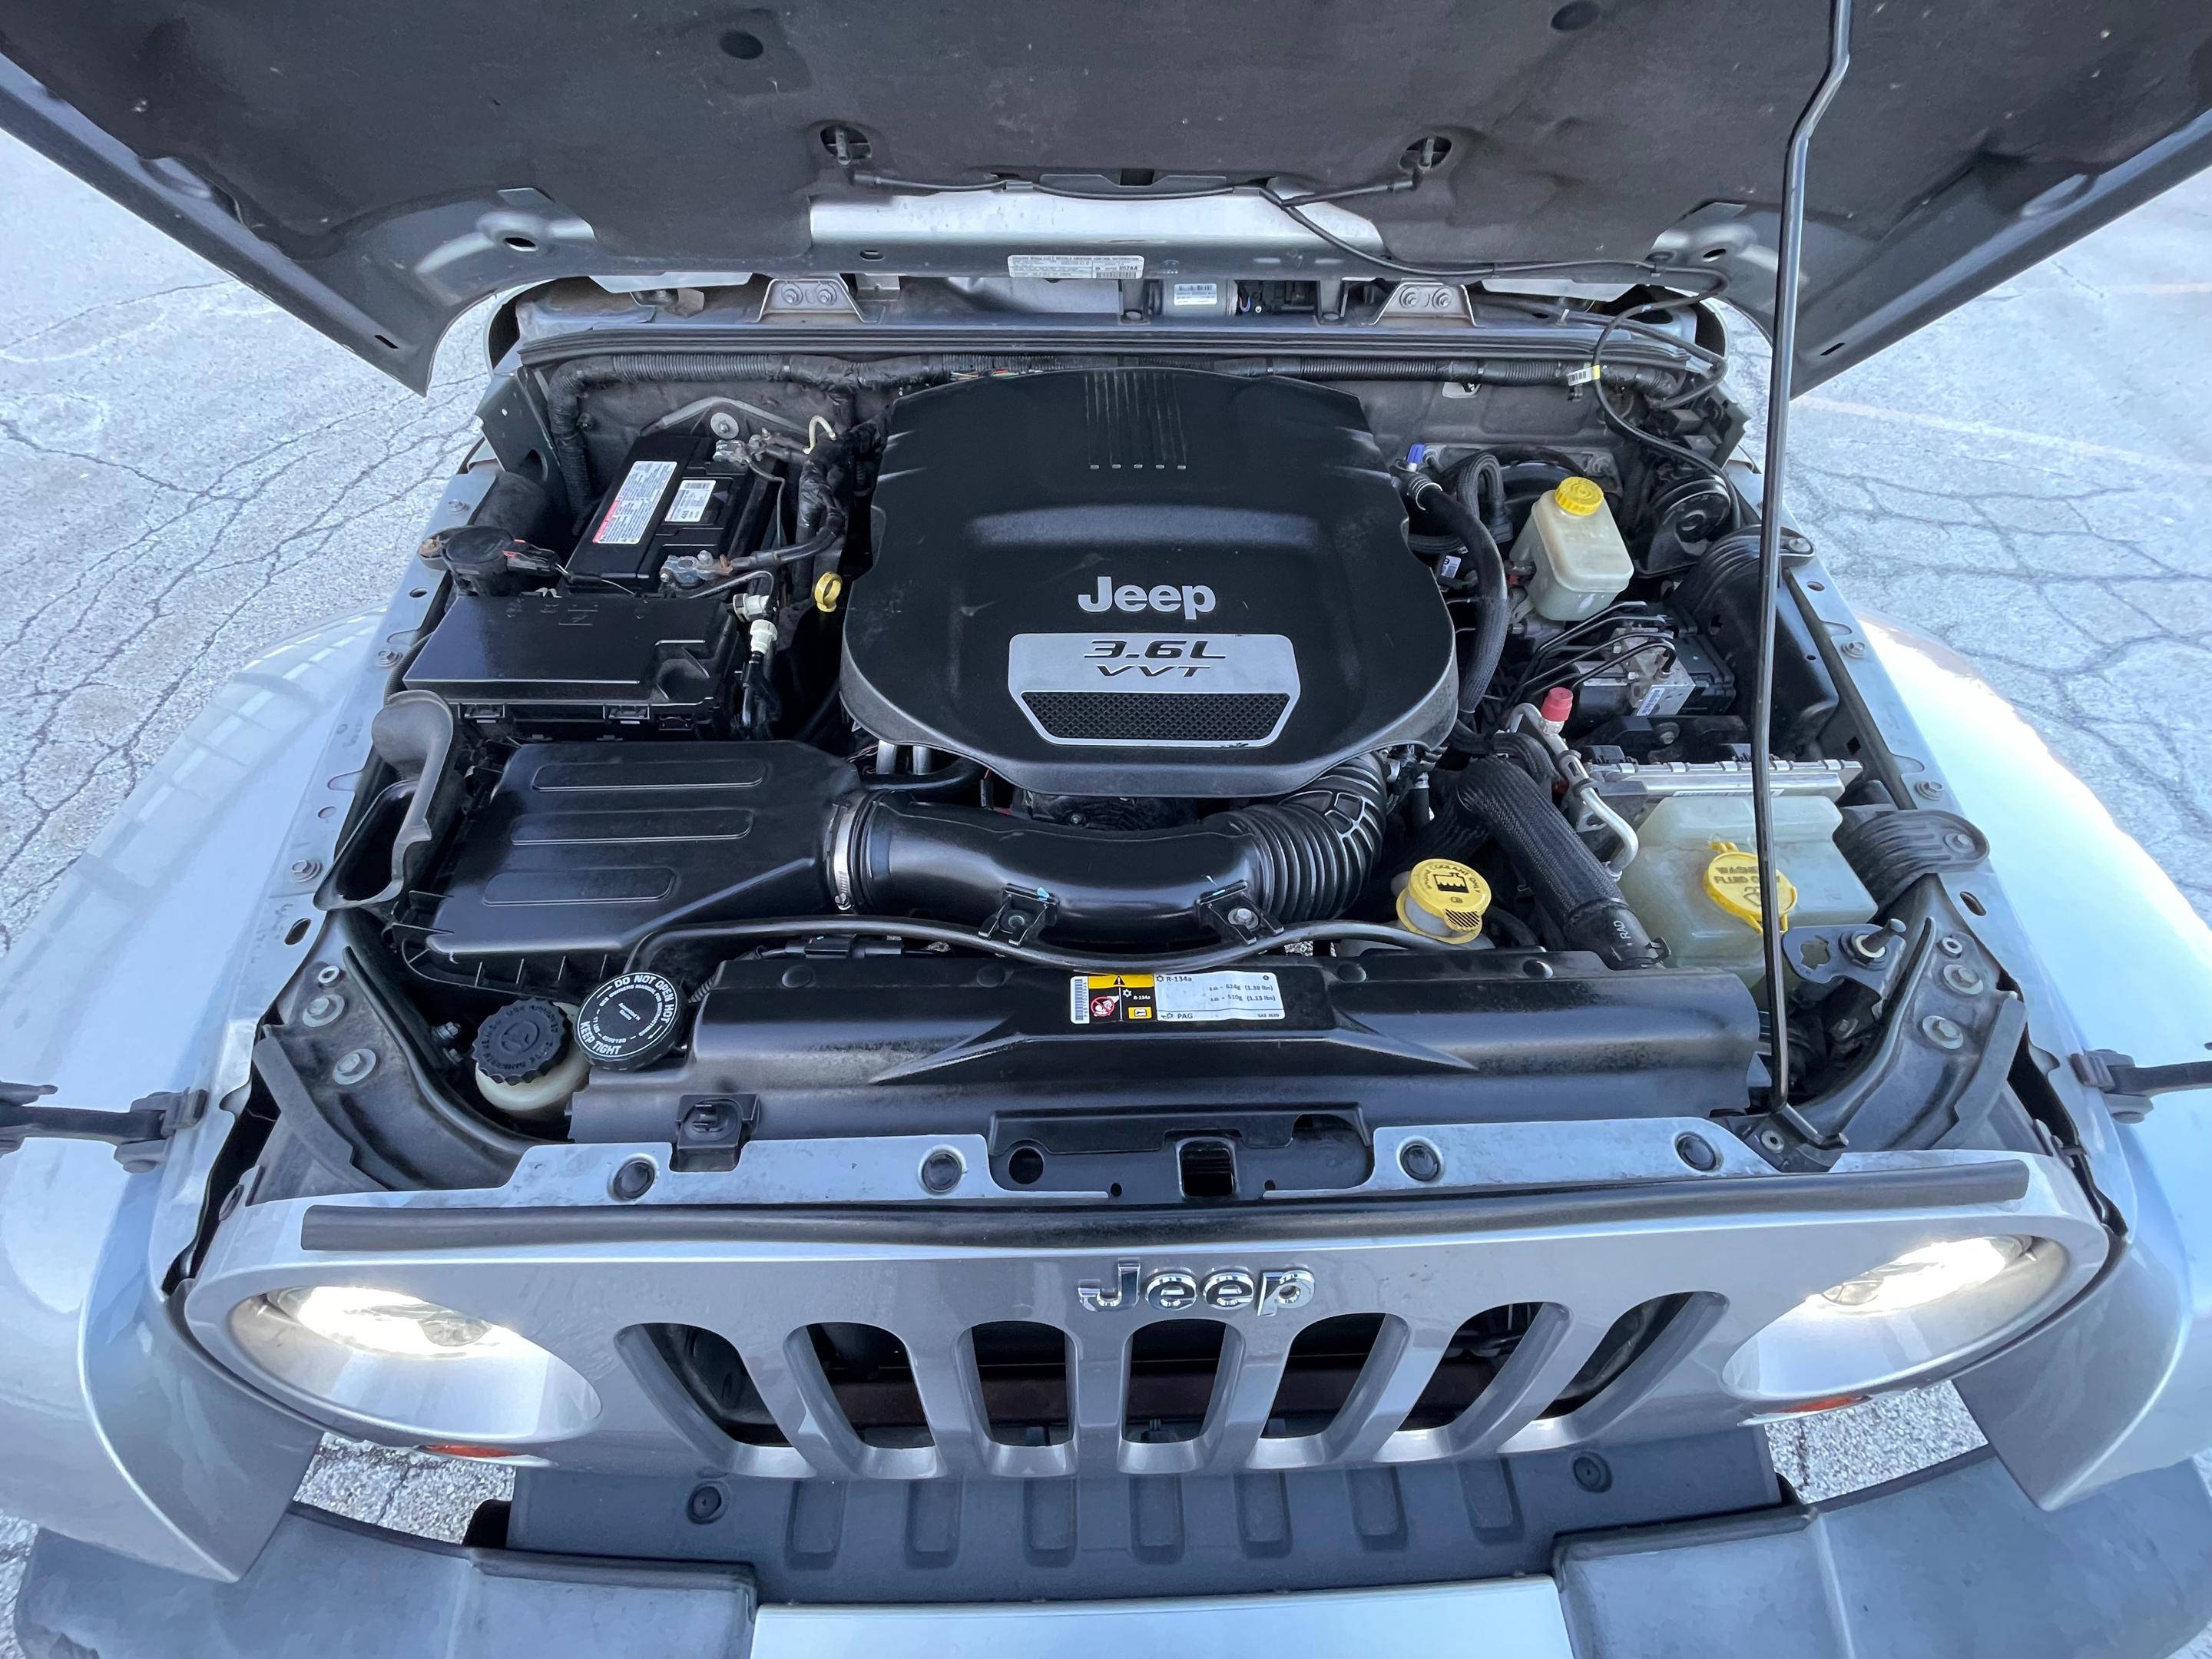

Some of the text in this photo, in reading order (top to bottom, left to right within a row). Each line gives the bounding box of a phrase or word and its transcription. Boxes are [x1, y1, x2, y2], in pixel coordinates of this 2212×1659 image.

[1078, 576, 1216, 621] Jeep
[1084, 640, 1227, 659] 3.6L
[1096, 664, 1211, 677] VVT
[1715, 866, 1759, 874] WASHE
[1613, 920, 1631, 939] RAD
[614, 975, 674, 1024] DO NOT OPEN HOT
[580, 1021, 596, 1044] KEEP
[592, 1040, 621, 1055] TIGHT
[1078, 1262, 1315, 1316] Jeep
